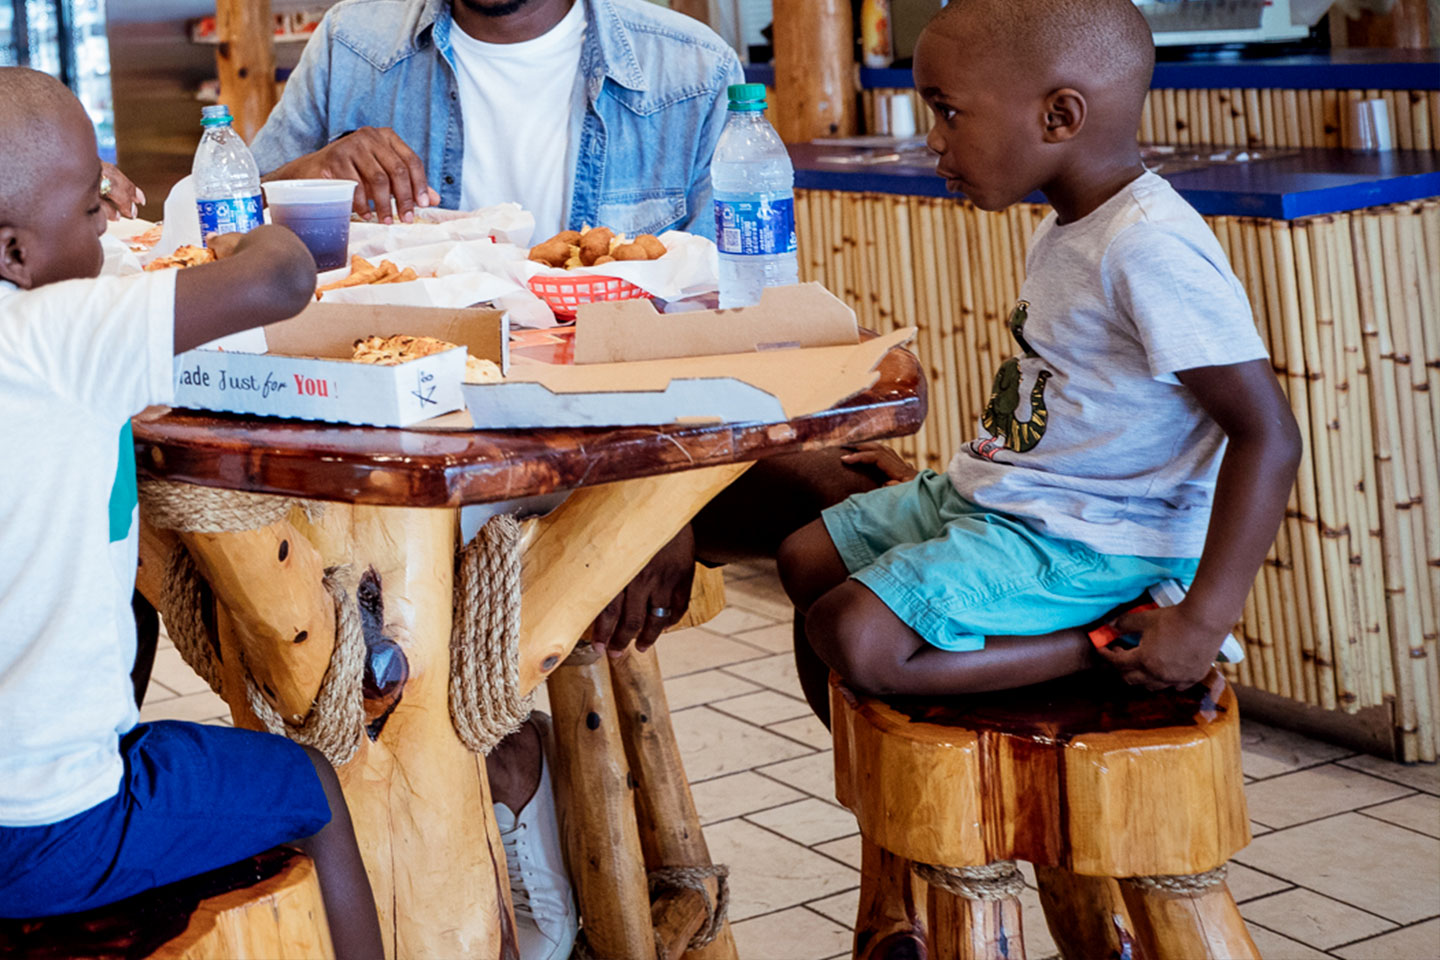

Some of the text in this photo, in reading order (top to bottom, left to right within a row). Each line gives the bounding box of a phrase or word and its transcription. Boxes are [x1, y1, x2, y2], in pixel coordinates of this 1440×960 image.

[180, 364, 210, 387] ade
[219, 369, 260, 391] Just
[262, 371, 287, 399] for
